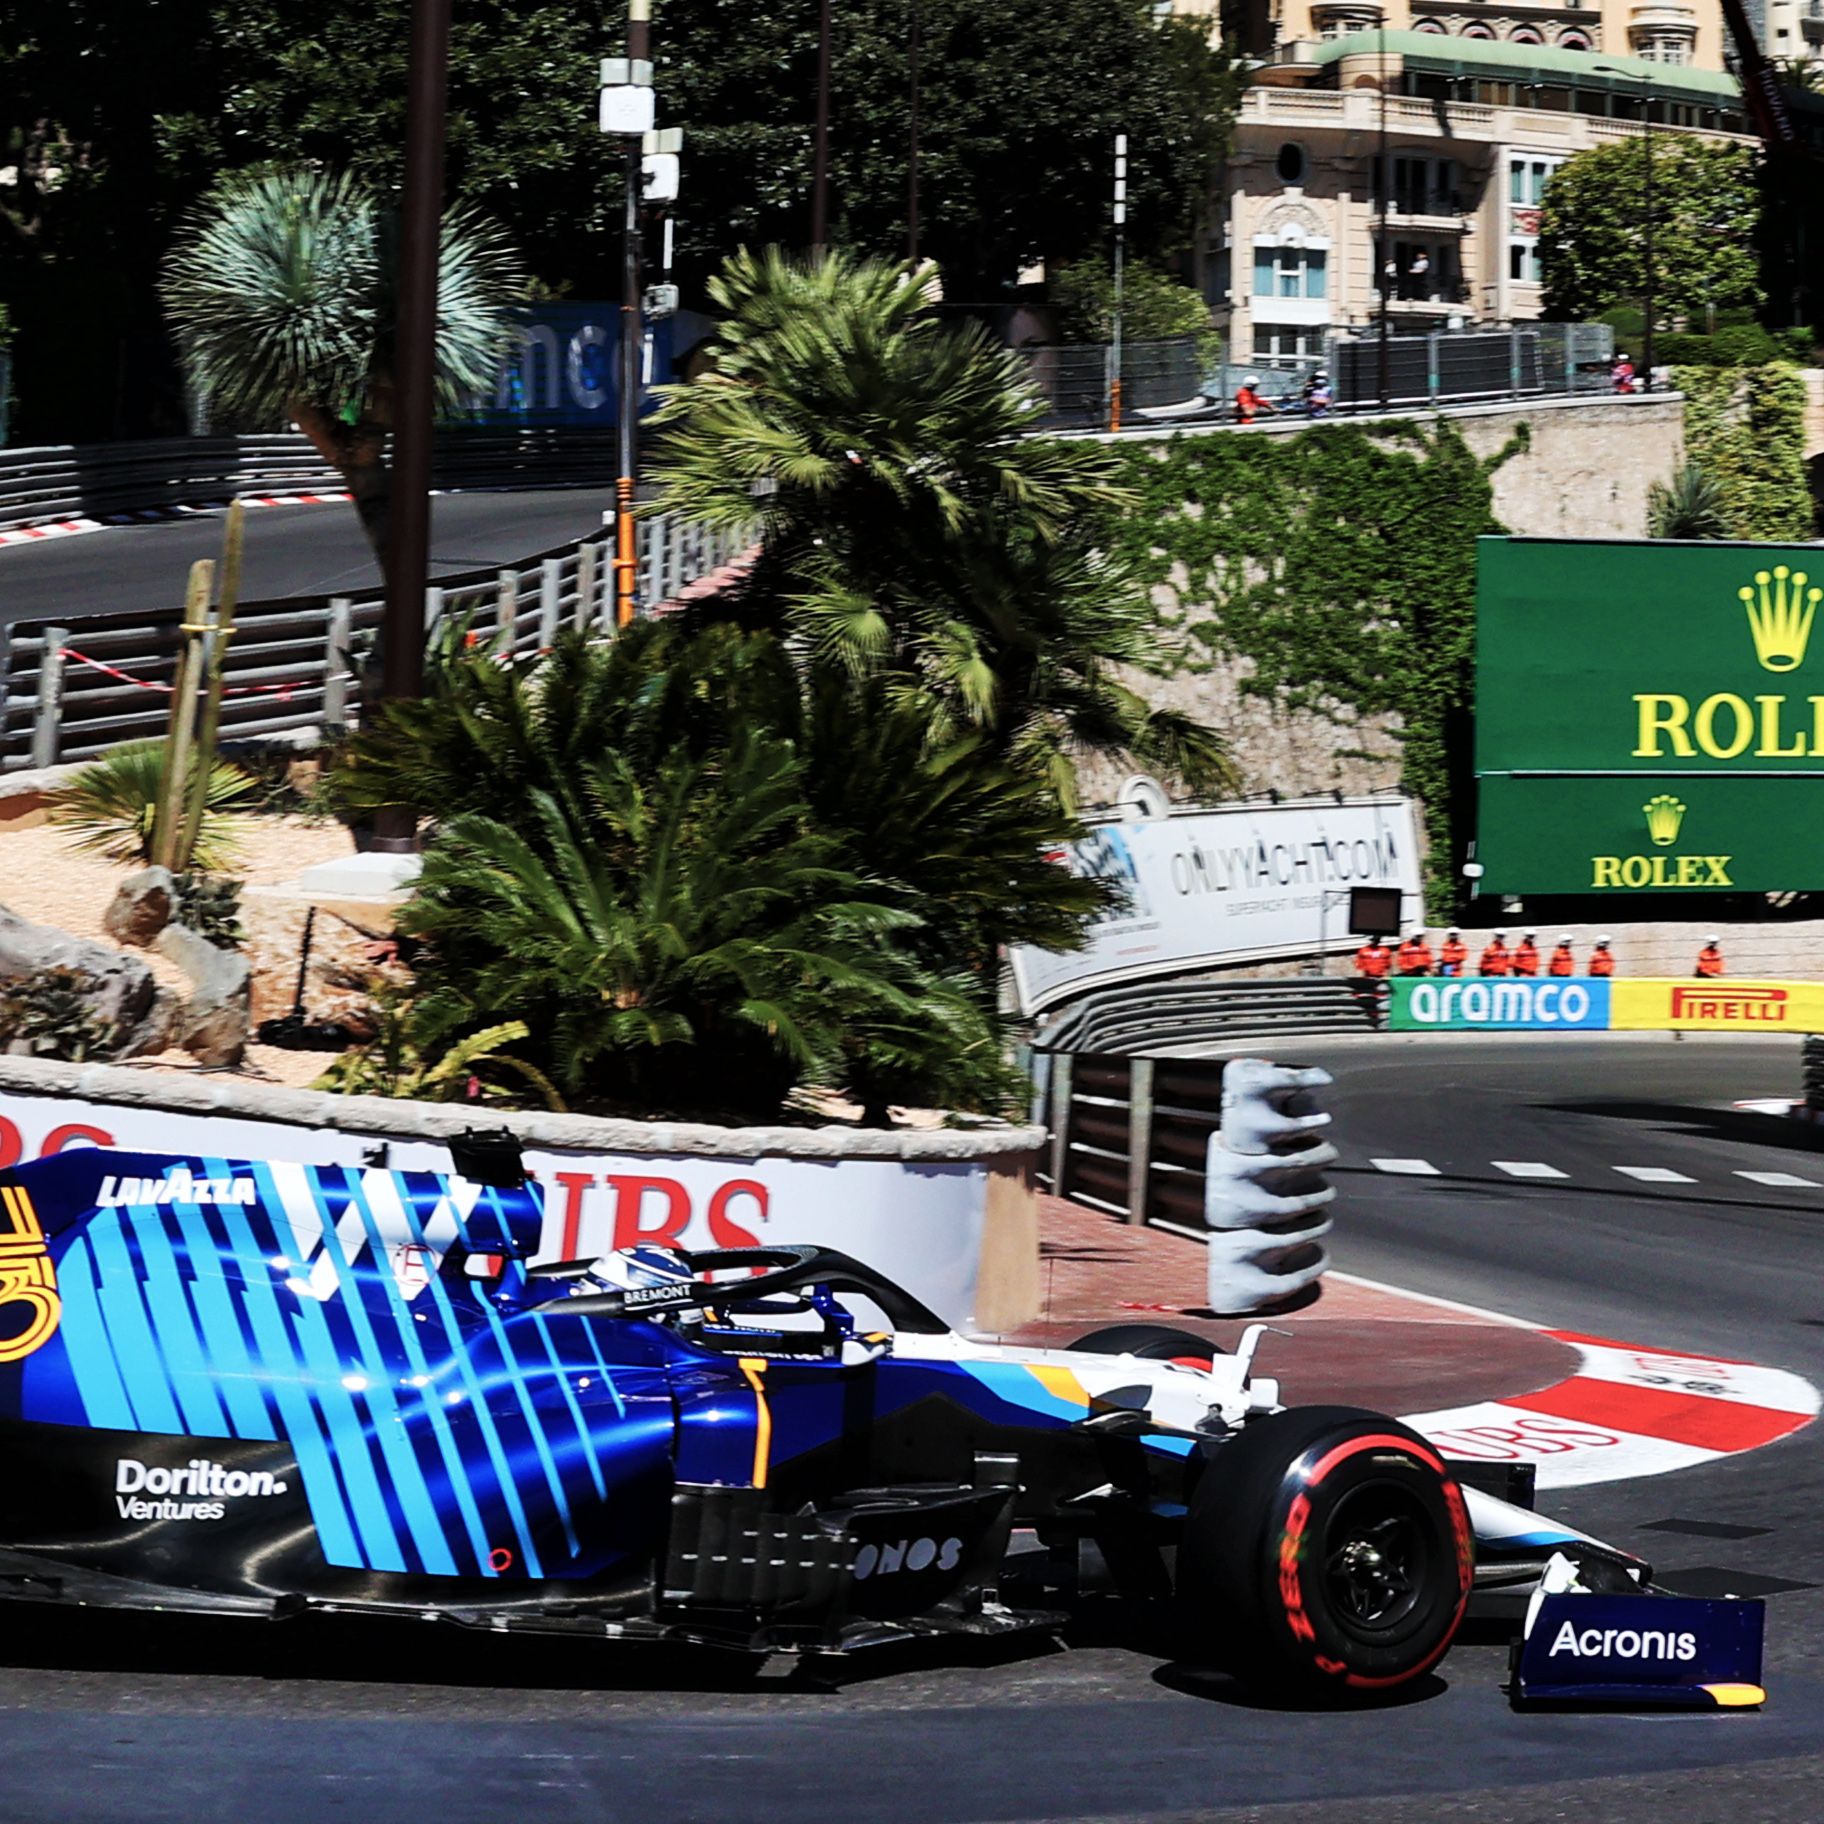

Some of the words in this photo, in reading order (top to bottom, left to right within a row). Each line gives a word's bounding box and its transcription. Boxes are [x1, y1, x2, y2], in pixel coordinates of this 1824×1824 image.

[1591, 855, 1734, 887] ROLEX
[1410, 981, 1591, 1023] aramco
[1671, 987, 1789, 1022] PIRELLI
[95, 1168, 257, 1208] LAVAZZA
[624, 1284, 692, 1304] BREMONT
[1425, 1418, 1620, 1461] UBS
[115, 1495, 225, 1520] Ventures
[853, 1537, 963, 1580] ONOS
[1549, 1621, 1697, 1661] Acronis
